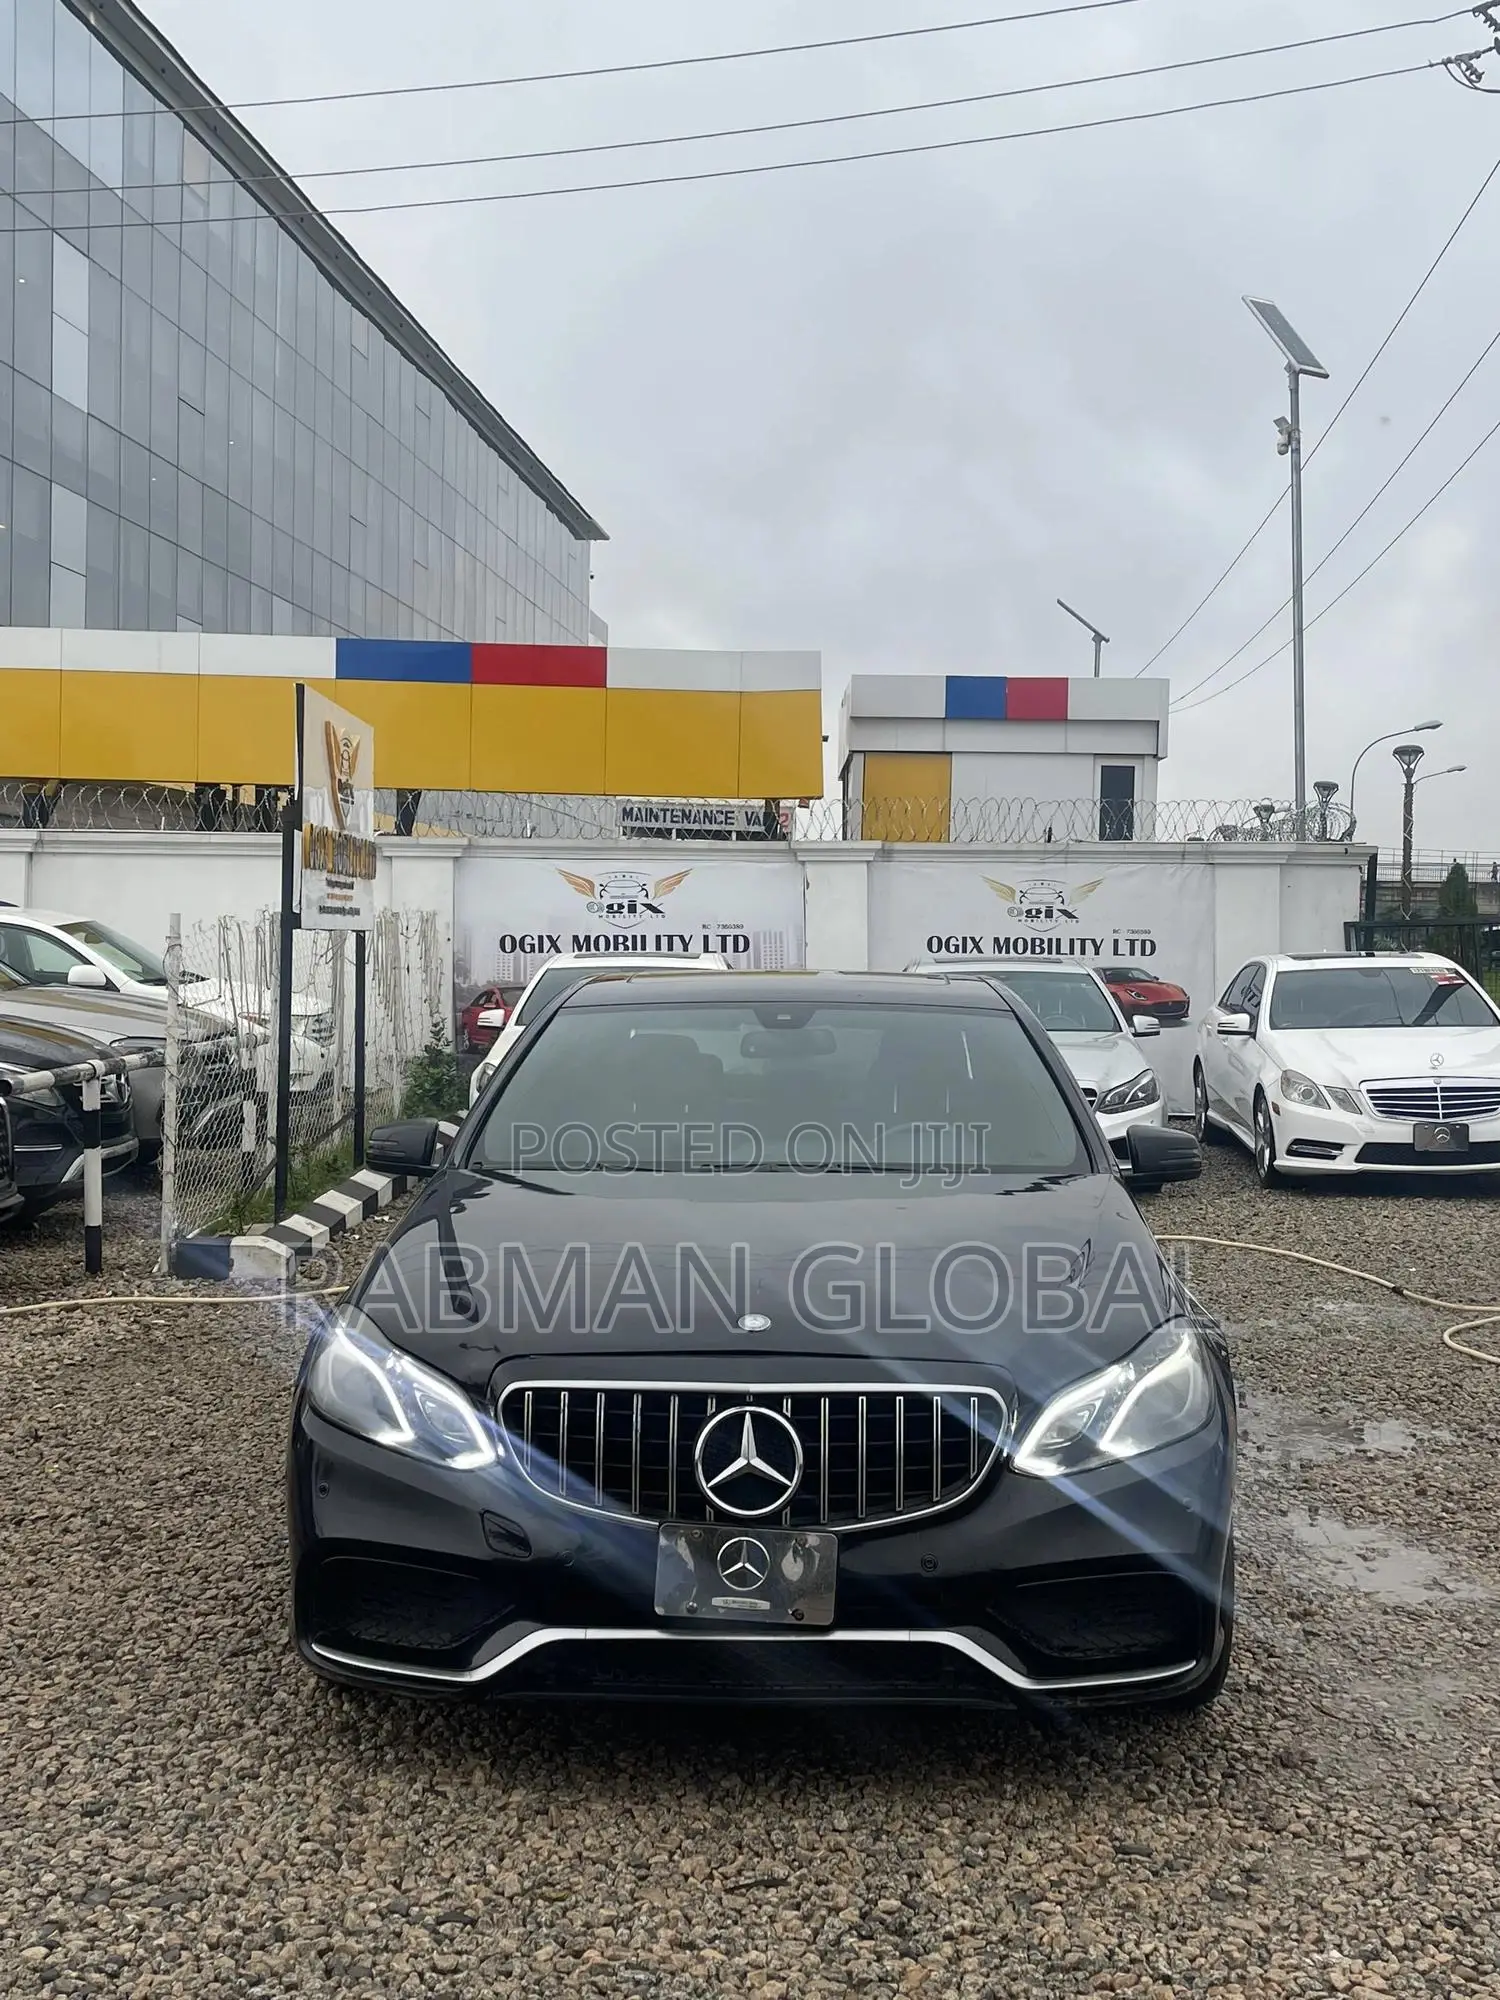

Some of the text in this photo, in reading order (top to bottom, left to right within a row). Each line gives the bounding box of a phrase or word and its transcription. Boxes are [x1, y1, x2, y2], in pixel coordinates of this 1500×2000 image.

[622, 806, 766, 827] MAINTENANCE VA
[499, 934, 750, 954] OGIX MOBILITY LTD
[927, 935, 1157, 957] OGIX MOBILITY LTD
